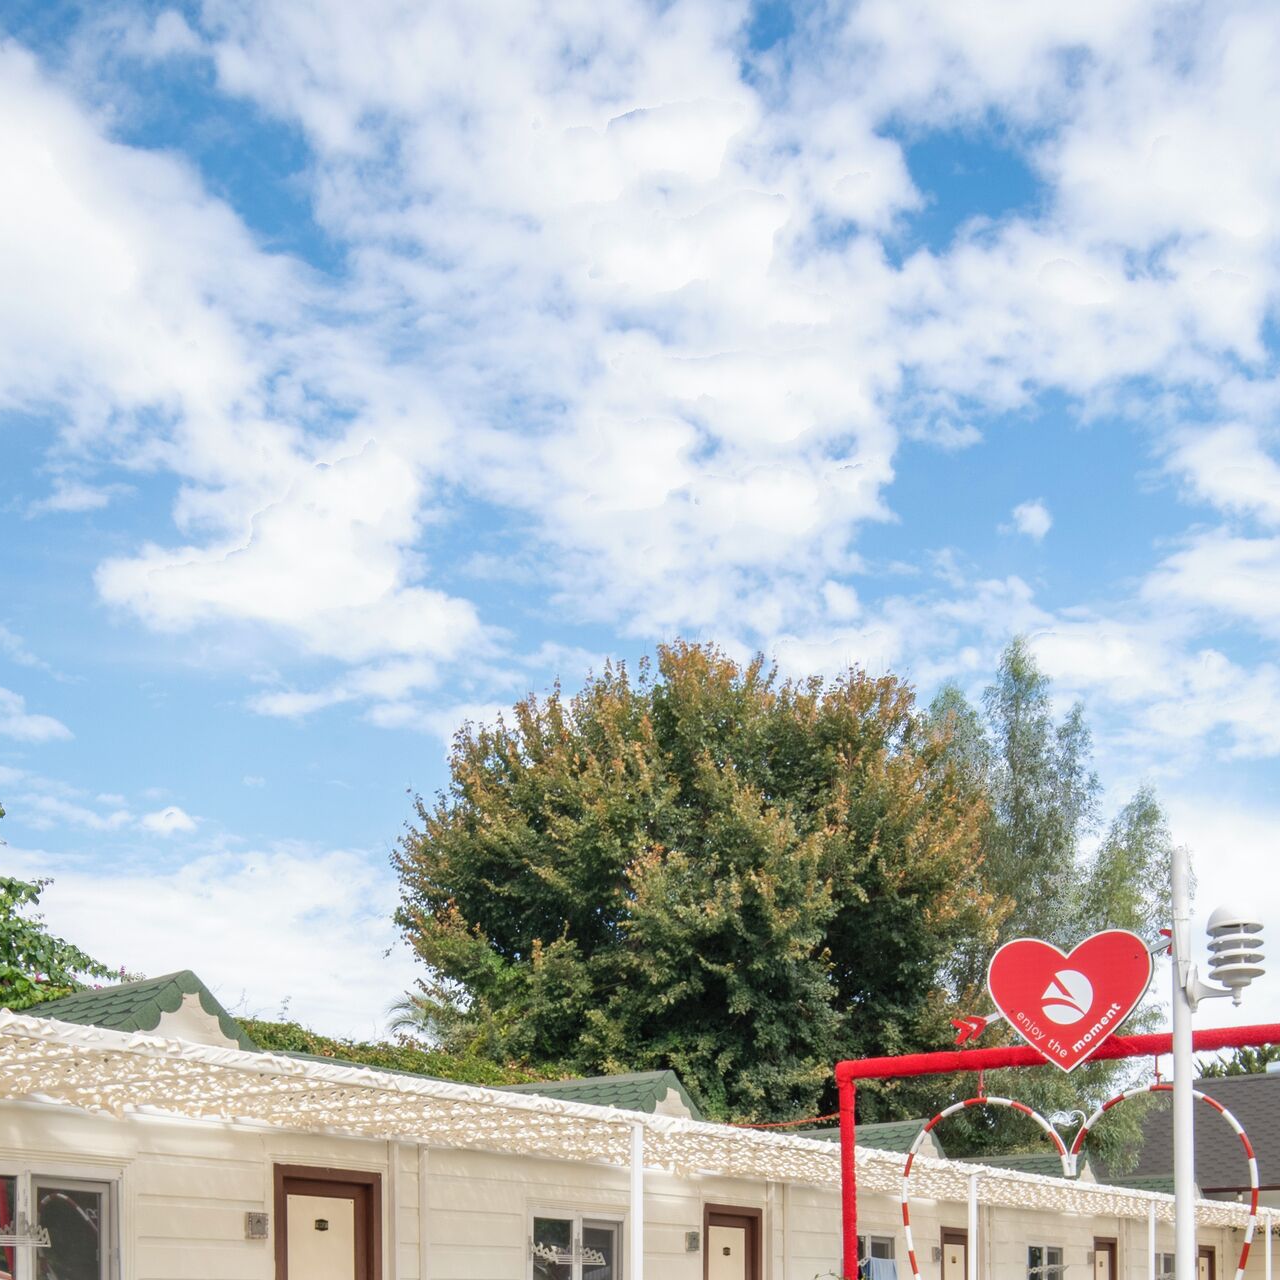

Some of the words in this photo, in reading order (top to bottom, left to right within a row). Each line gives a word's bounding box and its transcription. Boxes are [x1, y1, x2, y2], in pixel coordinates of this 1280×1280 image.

[1016, 1011, 1046, 1040] enjoy
[1047, 1038, 1068, 1058] the
[1072, 1002, 1121, 1053] moment
